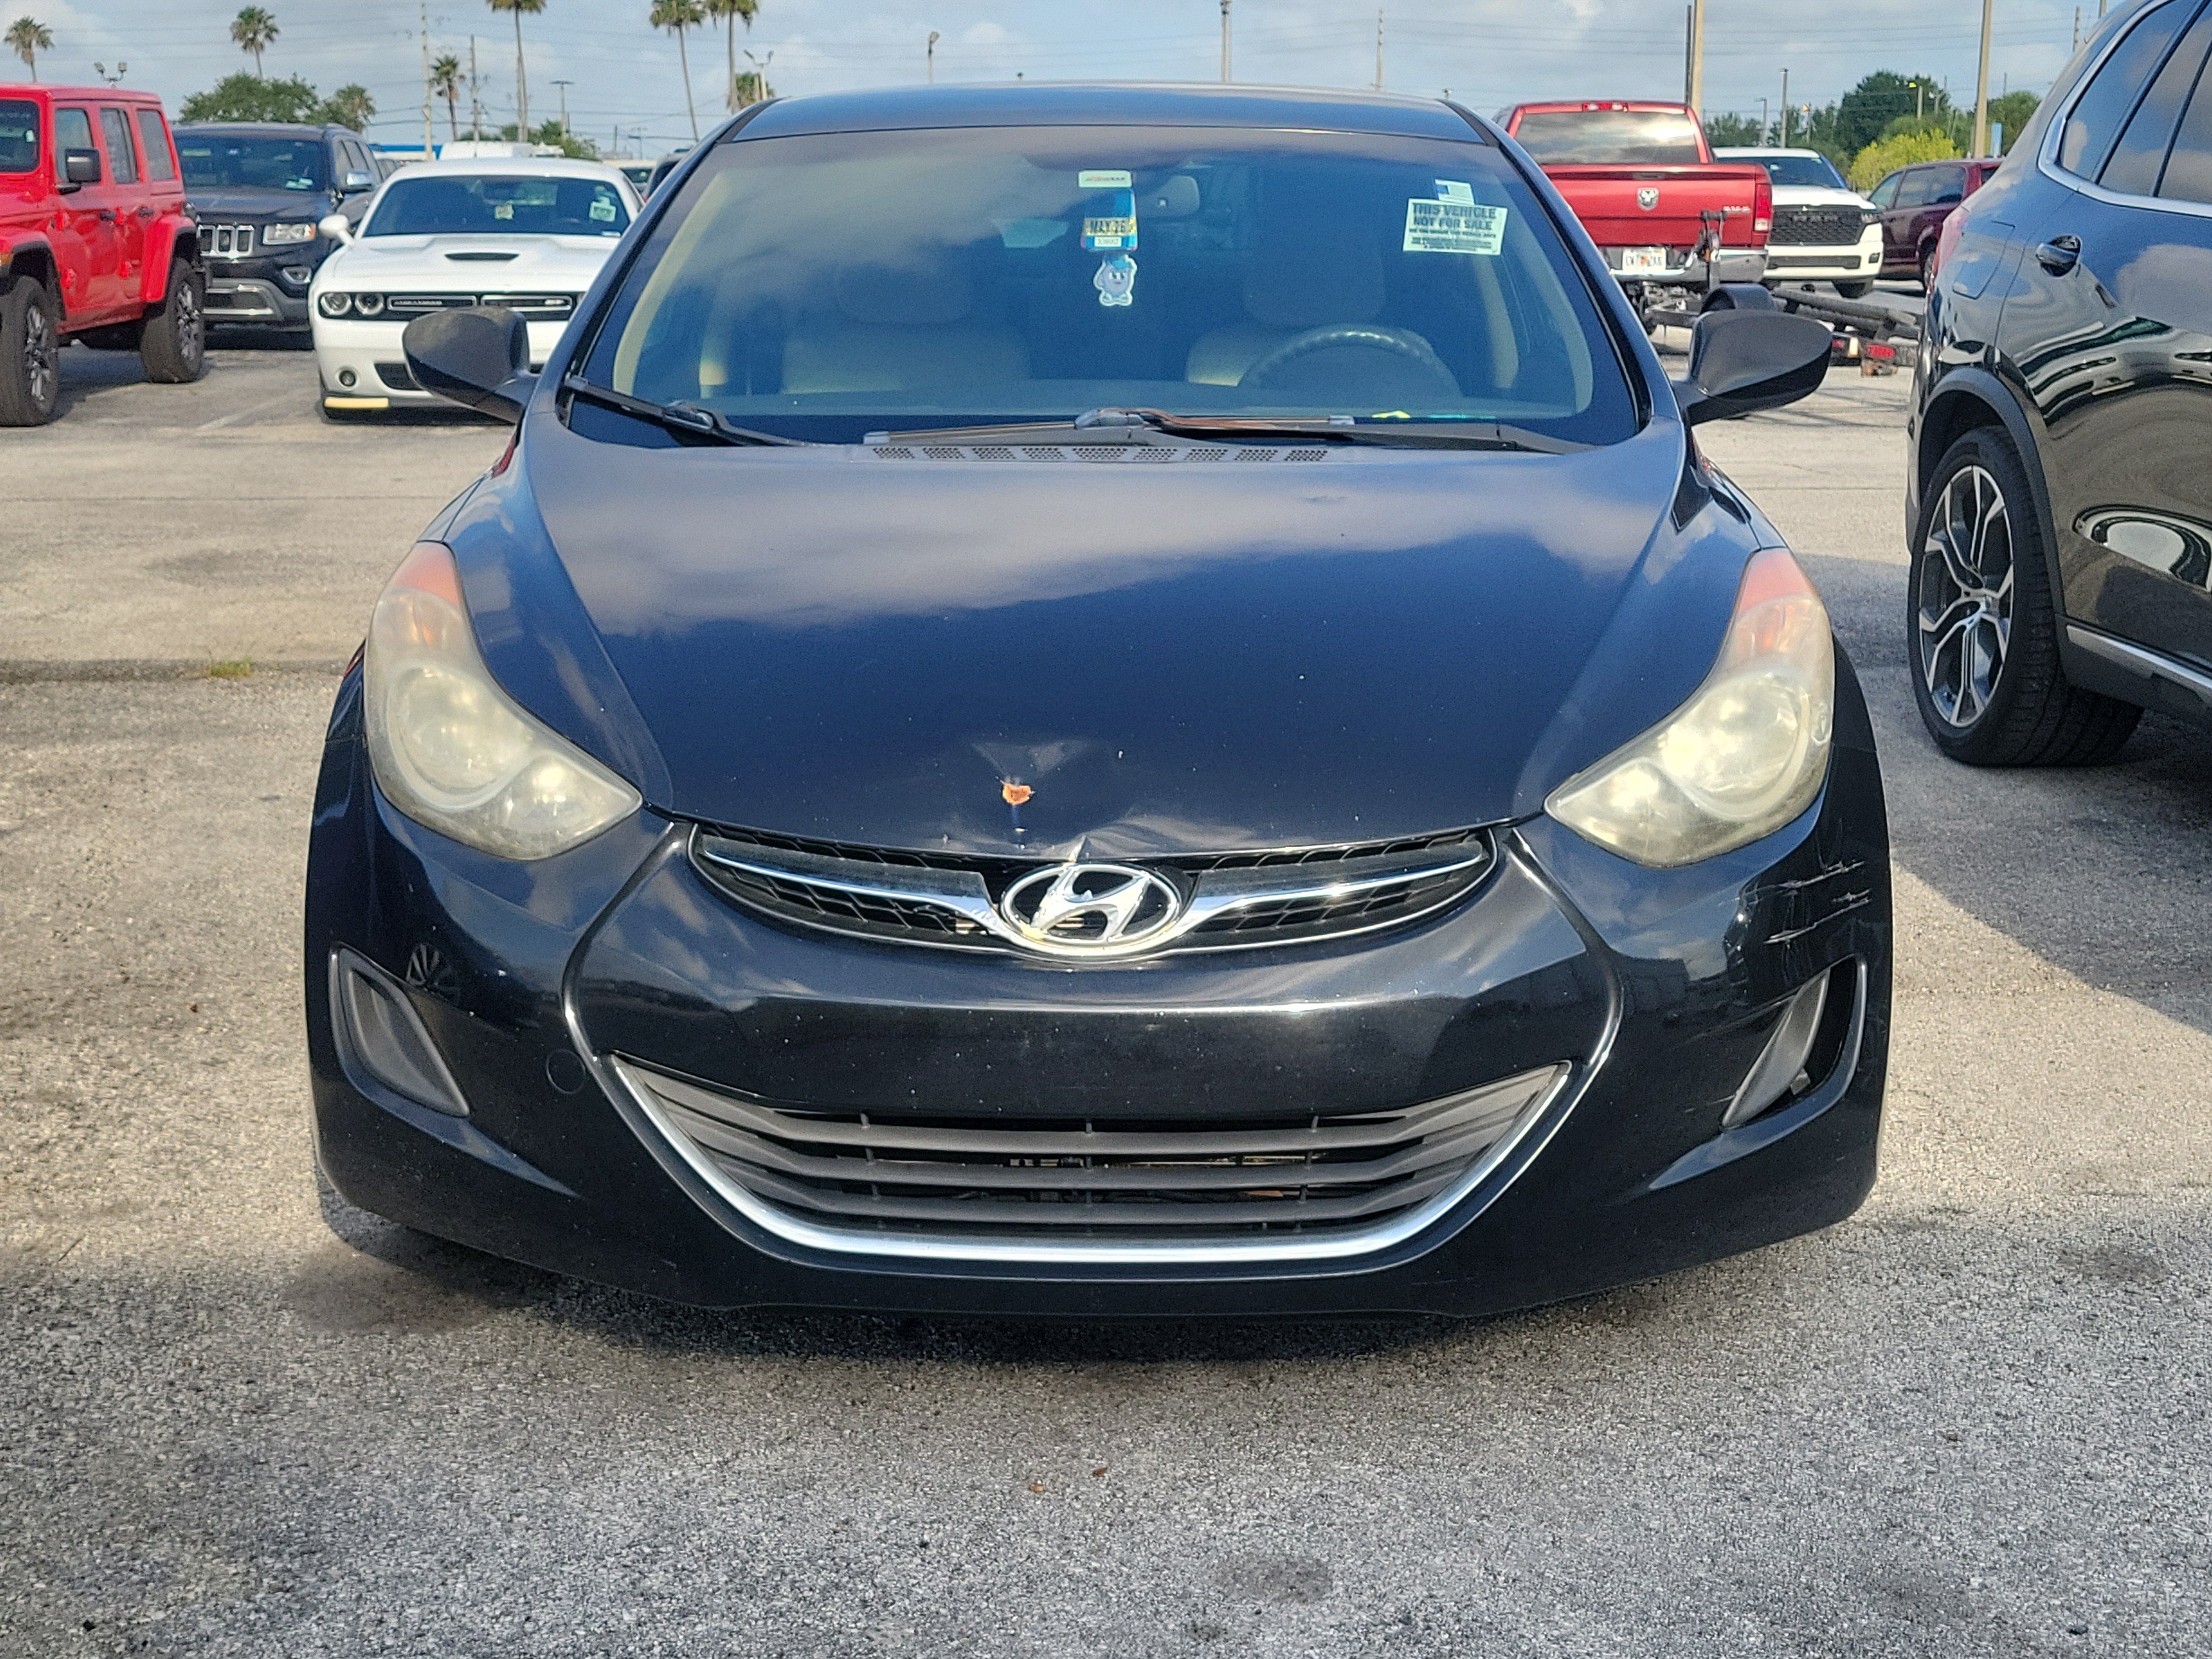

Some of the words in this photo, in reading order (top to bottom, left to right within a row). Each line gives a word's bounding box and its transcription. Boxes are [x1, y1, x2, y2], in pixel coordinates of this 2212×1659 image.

[1413, 203, 1441, 215] THIS
[1443, 205, 1496, 218] VEHICLE
[1090, 219, 1111, 234] MAY
[1413, 217, 1435, 226] NOT
[1439, 218, 1460, 228] FOR
[1464, 219, 1492, 230] SALE
